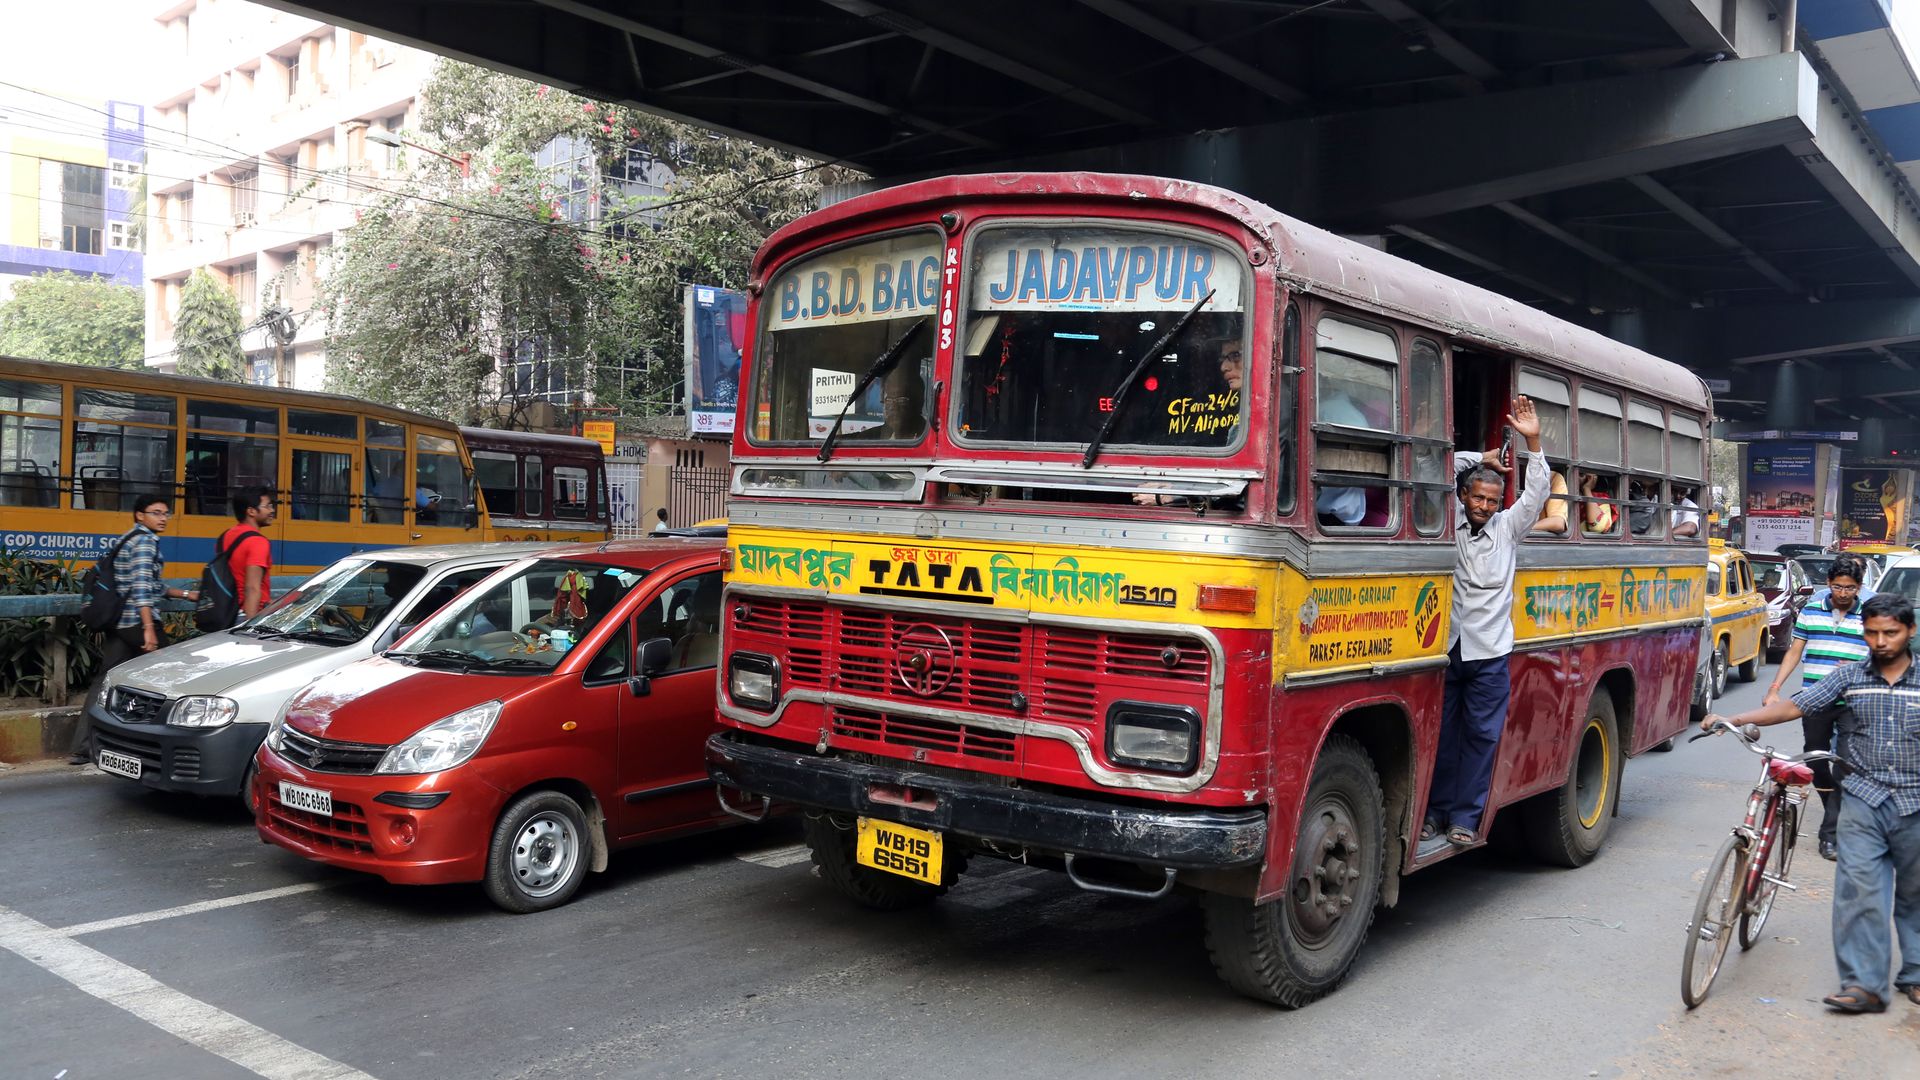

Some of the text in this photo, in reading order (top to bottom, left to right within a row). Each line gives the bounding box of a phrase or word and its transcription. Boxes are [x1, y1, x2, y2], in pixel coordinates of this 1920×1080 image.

[872, 255, 940, 315] BAG
[989, 245, 1216, 304] JADAVPUR
[815, 374, 852, 386] PRITHVI
[623, 446, 646, 457] HOME
[4, 534, 36, 547] GOD
[40, 535, 93, 549] CHURCH
[738, 544, 855, 588] যাদবপুর
[869, 559, 984, 592] TATA
[1120, 584, 1177, 604] 1510
[1359, 586, 1397, 605] GARIAHAT
[1346, 638, 1393, 659] ESPLANADE
[873, 847, 928, 878] 6551
